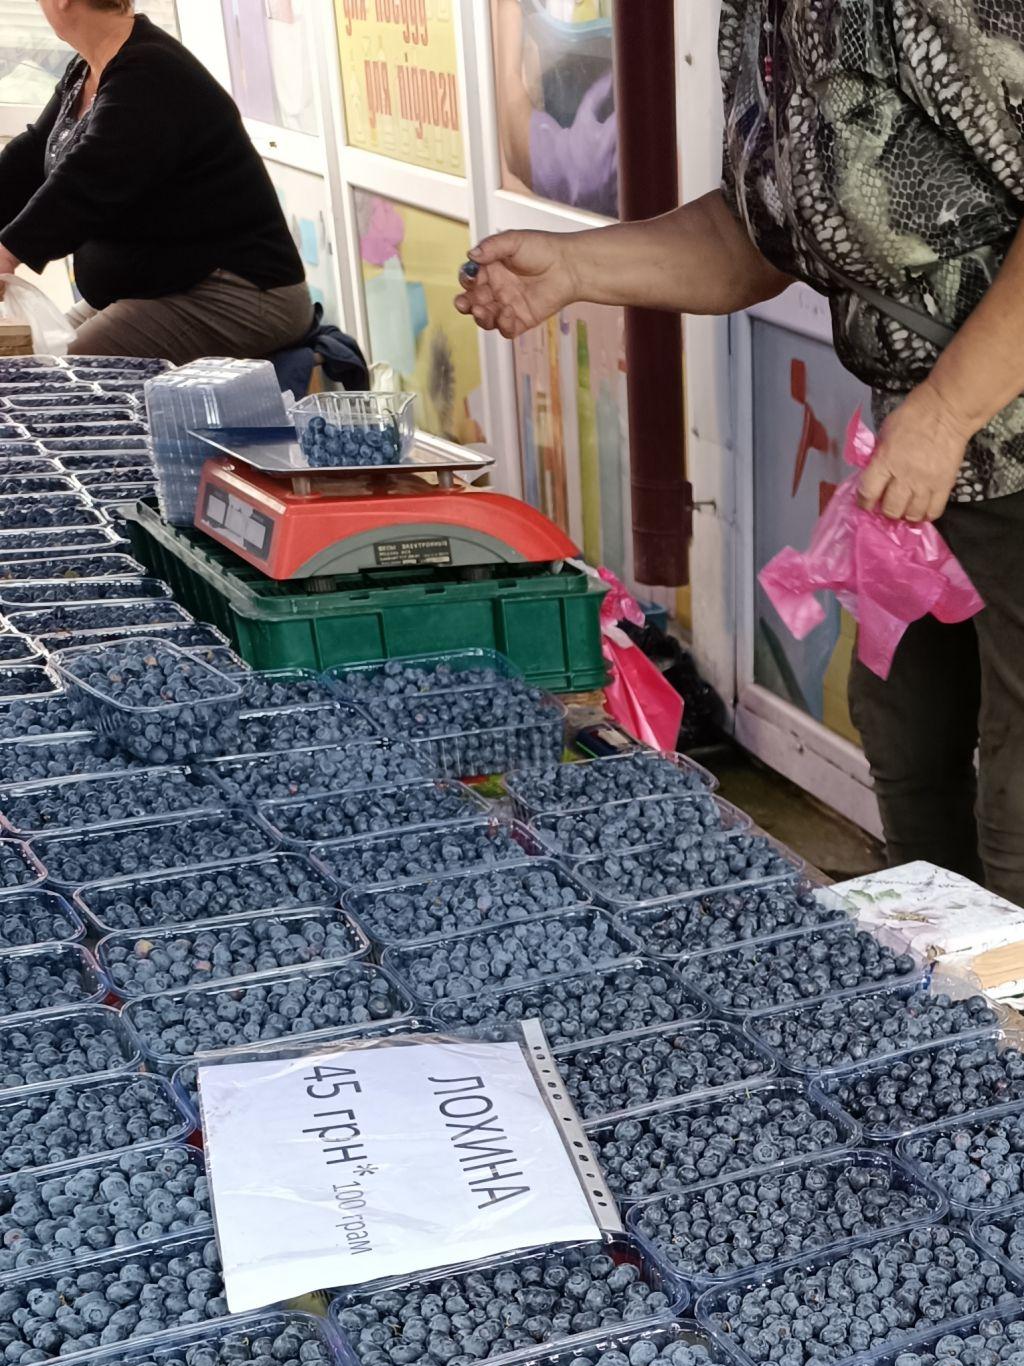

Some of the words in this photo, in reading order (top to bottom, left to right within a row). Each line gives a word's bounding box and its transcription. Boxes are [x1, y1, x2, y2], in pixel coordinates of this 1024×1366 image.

[303, 1065, 362, 1099] 45
[428, 1075, 531, 1210] ЛОХИНА
[332, 1180, 367, 1210] 100
[335, 1214, 373, 1255] грам
